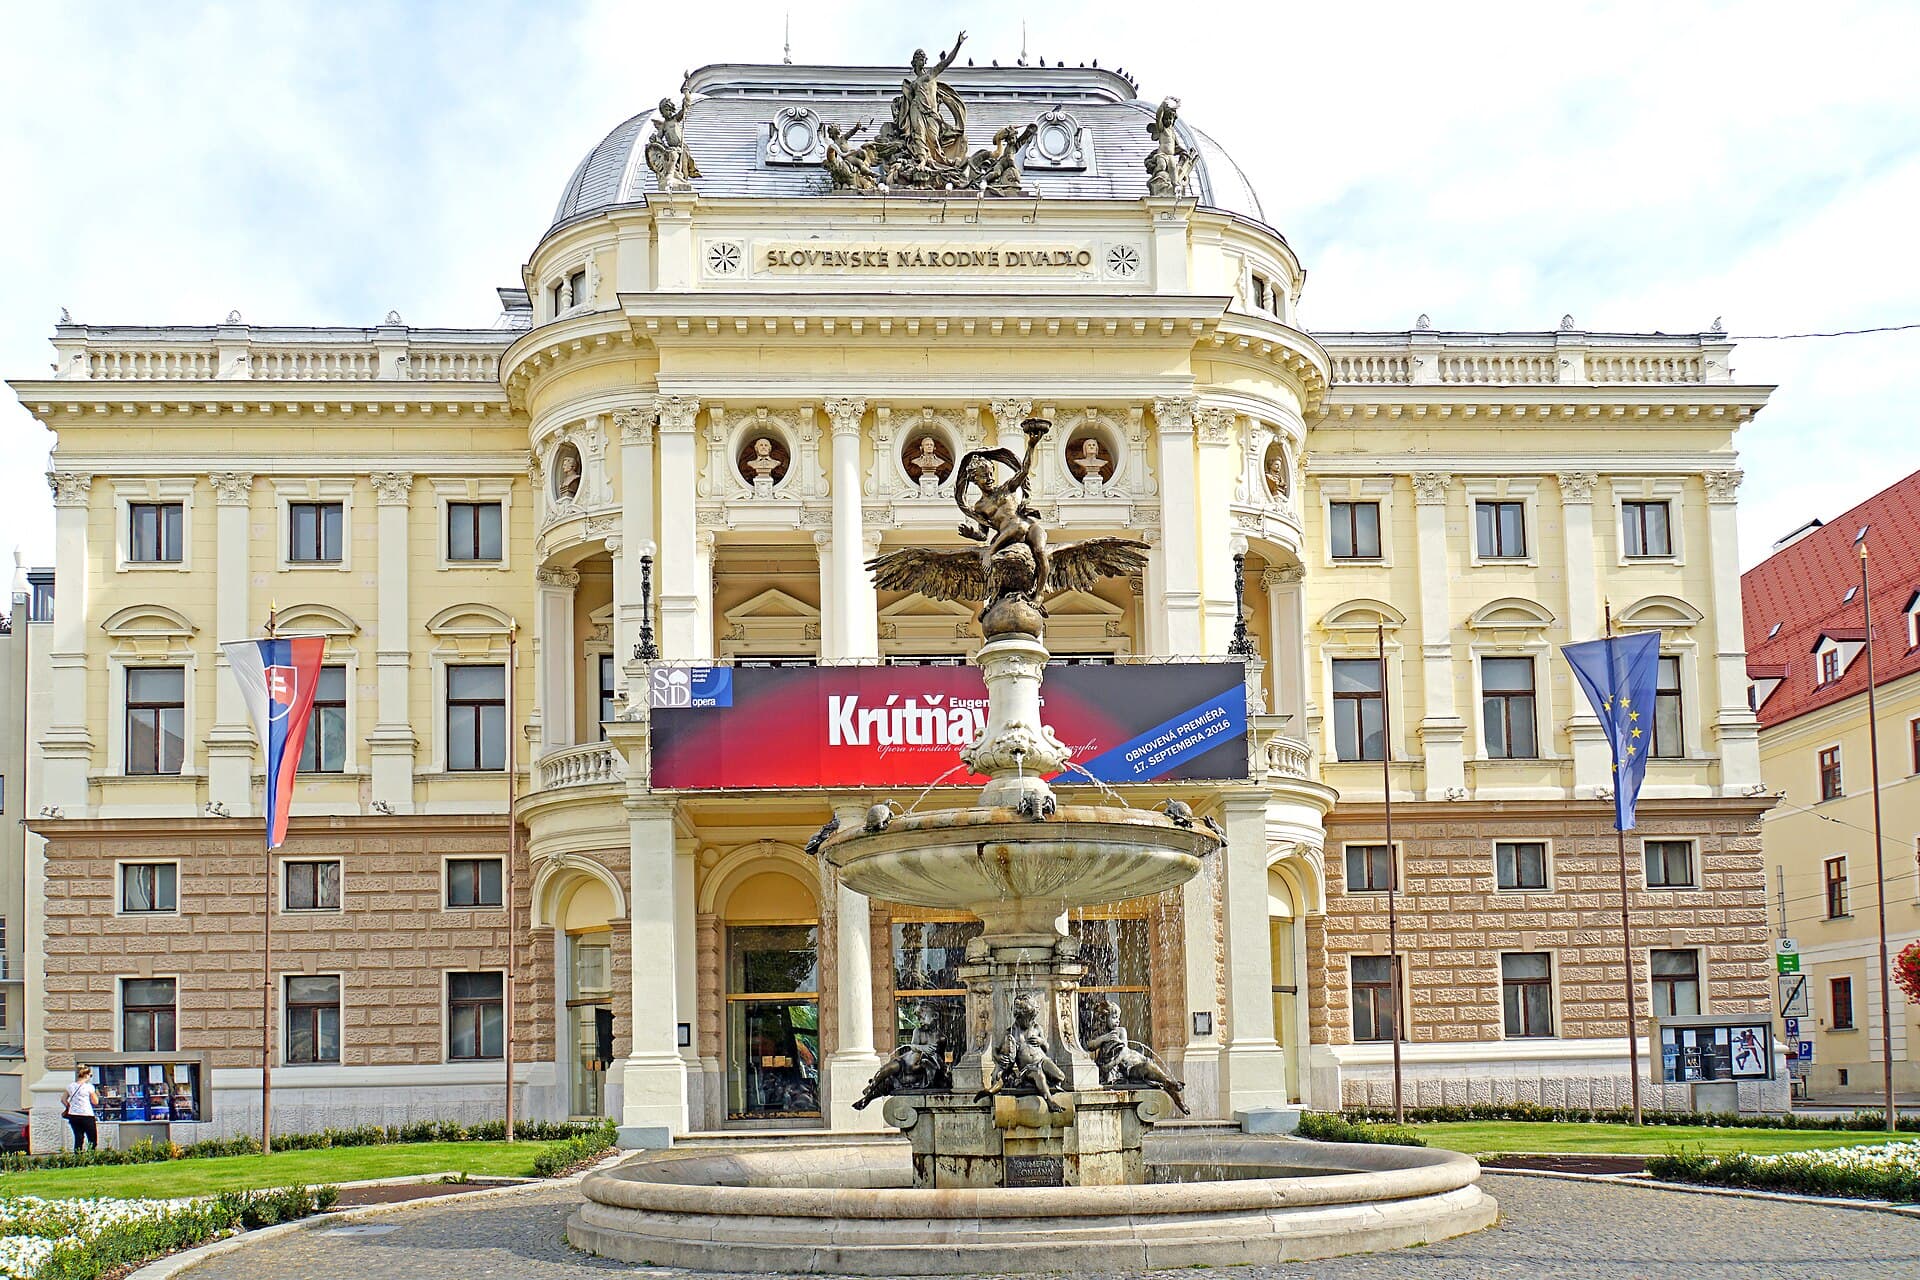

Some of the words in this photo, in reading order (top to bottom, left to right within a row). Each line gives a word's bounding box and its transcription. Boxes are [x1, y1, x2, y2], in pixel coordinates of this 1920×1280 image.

[767, 247, 889, 268] SLOVENSKÉ
[896, 247, 1000, 268] NÁRODNÉ
[1004, 249, 1093, 268] DIVADLO
[692, 698, 716, 708] opera
[827, 694, 990, 746] Krútňav
[1125, 729, 1178, 762] OBNOVENÁ
[1176, 706, 1227, 737] PREMIÉRA
[877, 742, 906, 760] Opera
[1066, 737, 1097, 758] azyku
[1133, 761, 1149, 774] 17.
[1147, 732, 1206, 766] SEPTEMBRA
[1204, 719, 1231, 738] 2016
[1801, 1043, 1809, 1055] P
